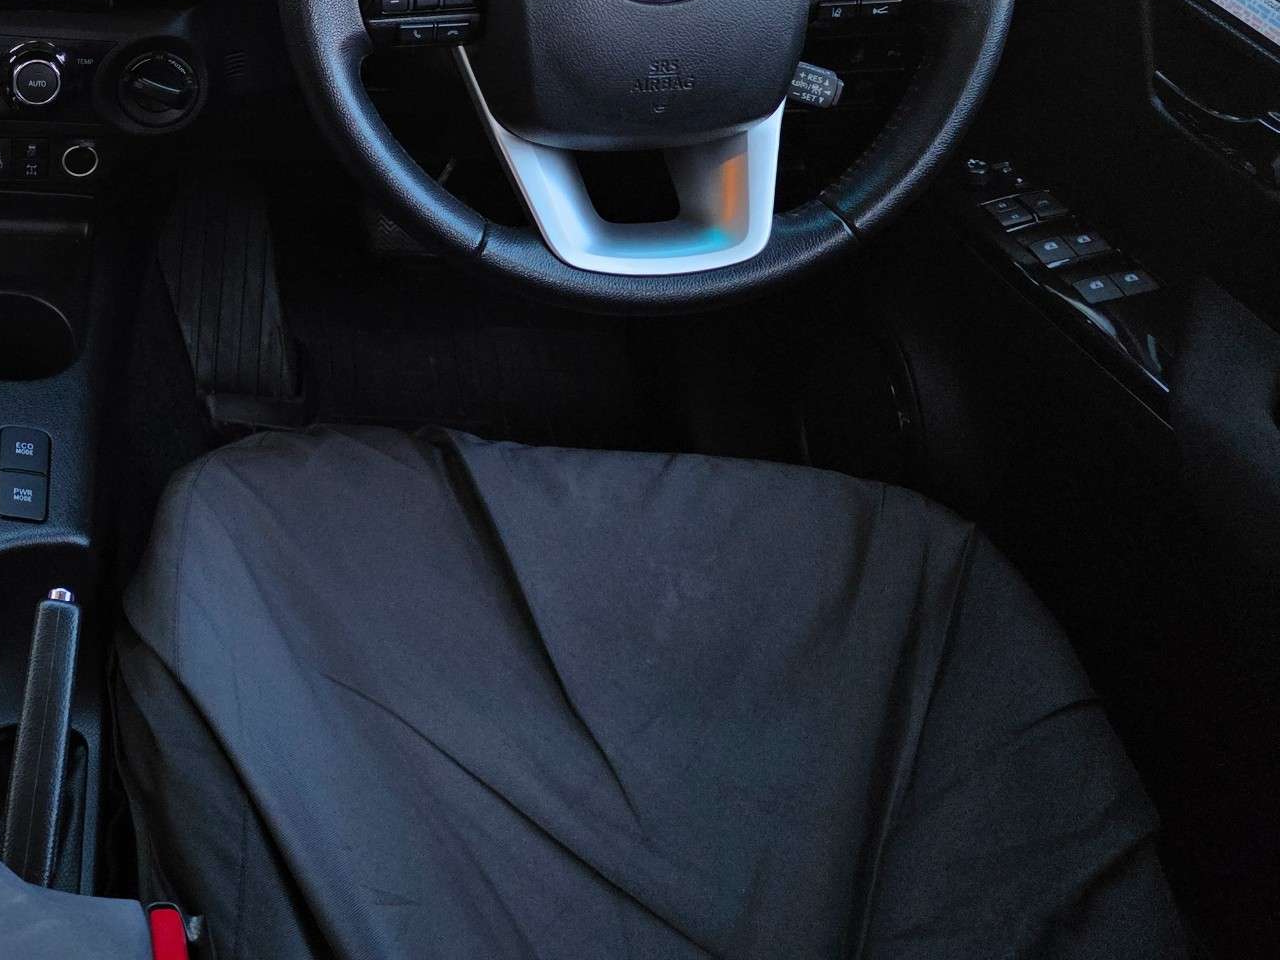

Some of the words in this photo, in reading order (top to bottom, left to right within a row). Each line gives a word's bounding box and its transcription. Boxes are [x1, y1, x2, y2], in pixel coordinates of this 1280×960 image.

[648, 59, 679, 74] SRS
[807, 73, 823, 83] RES
[28, 80, 47, 88] AUTO
[15, 448, 34, 456] MODE
[13, 487, 33, 496] PWR
[13, 495, 32, 503] MODE
